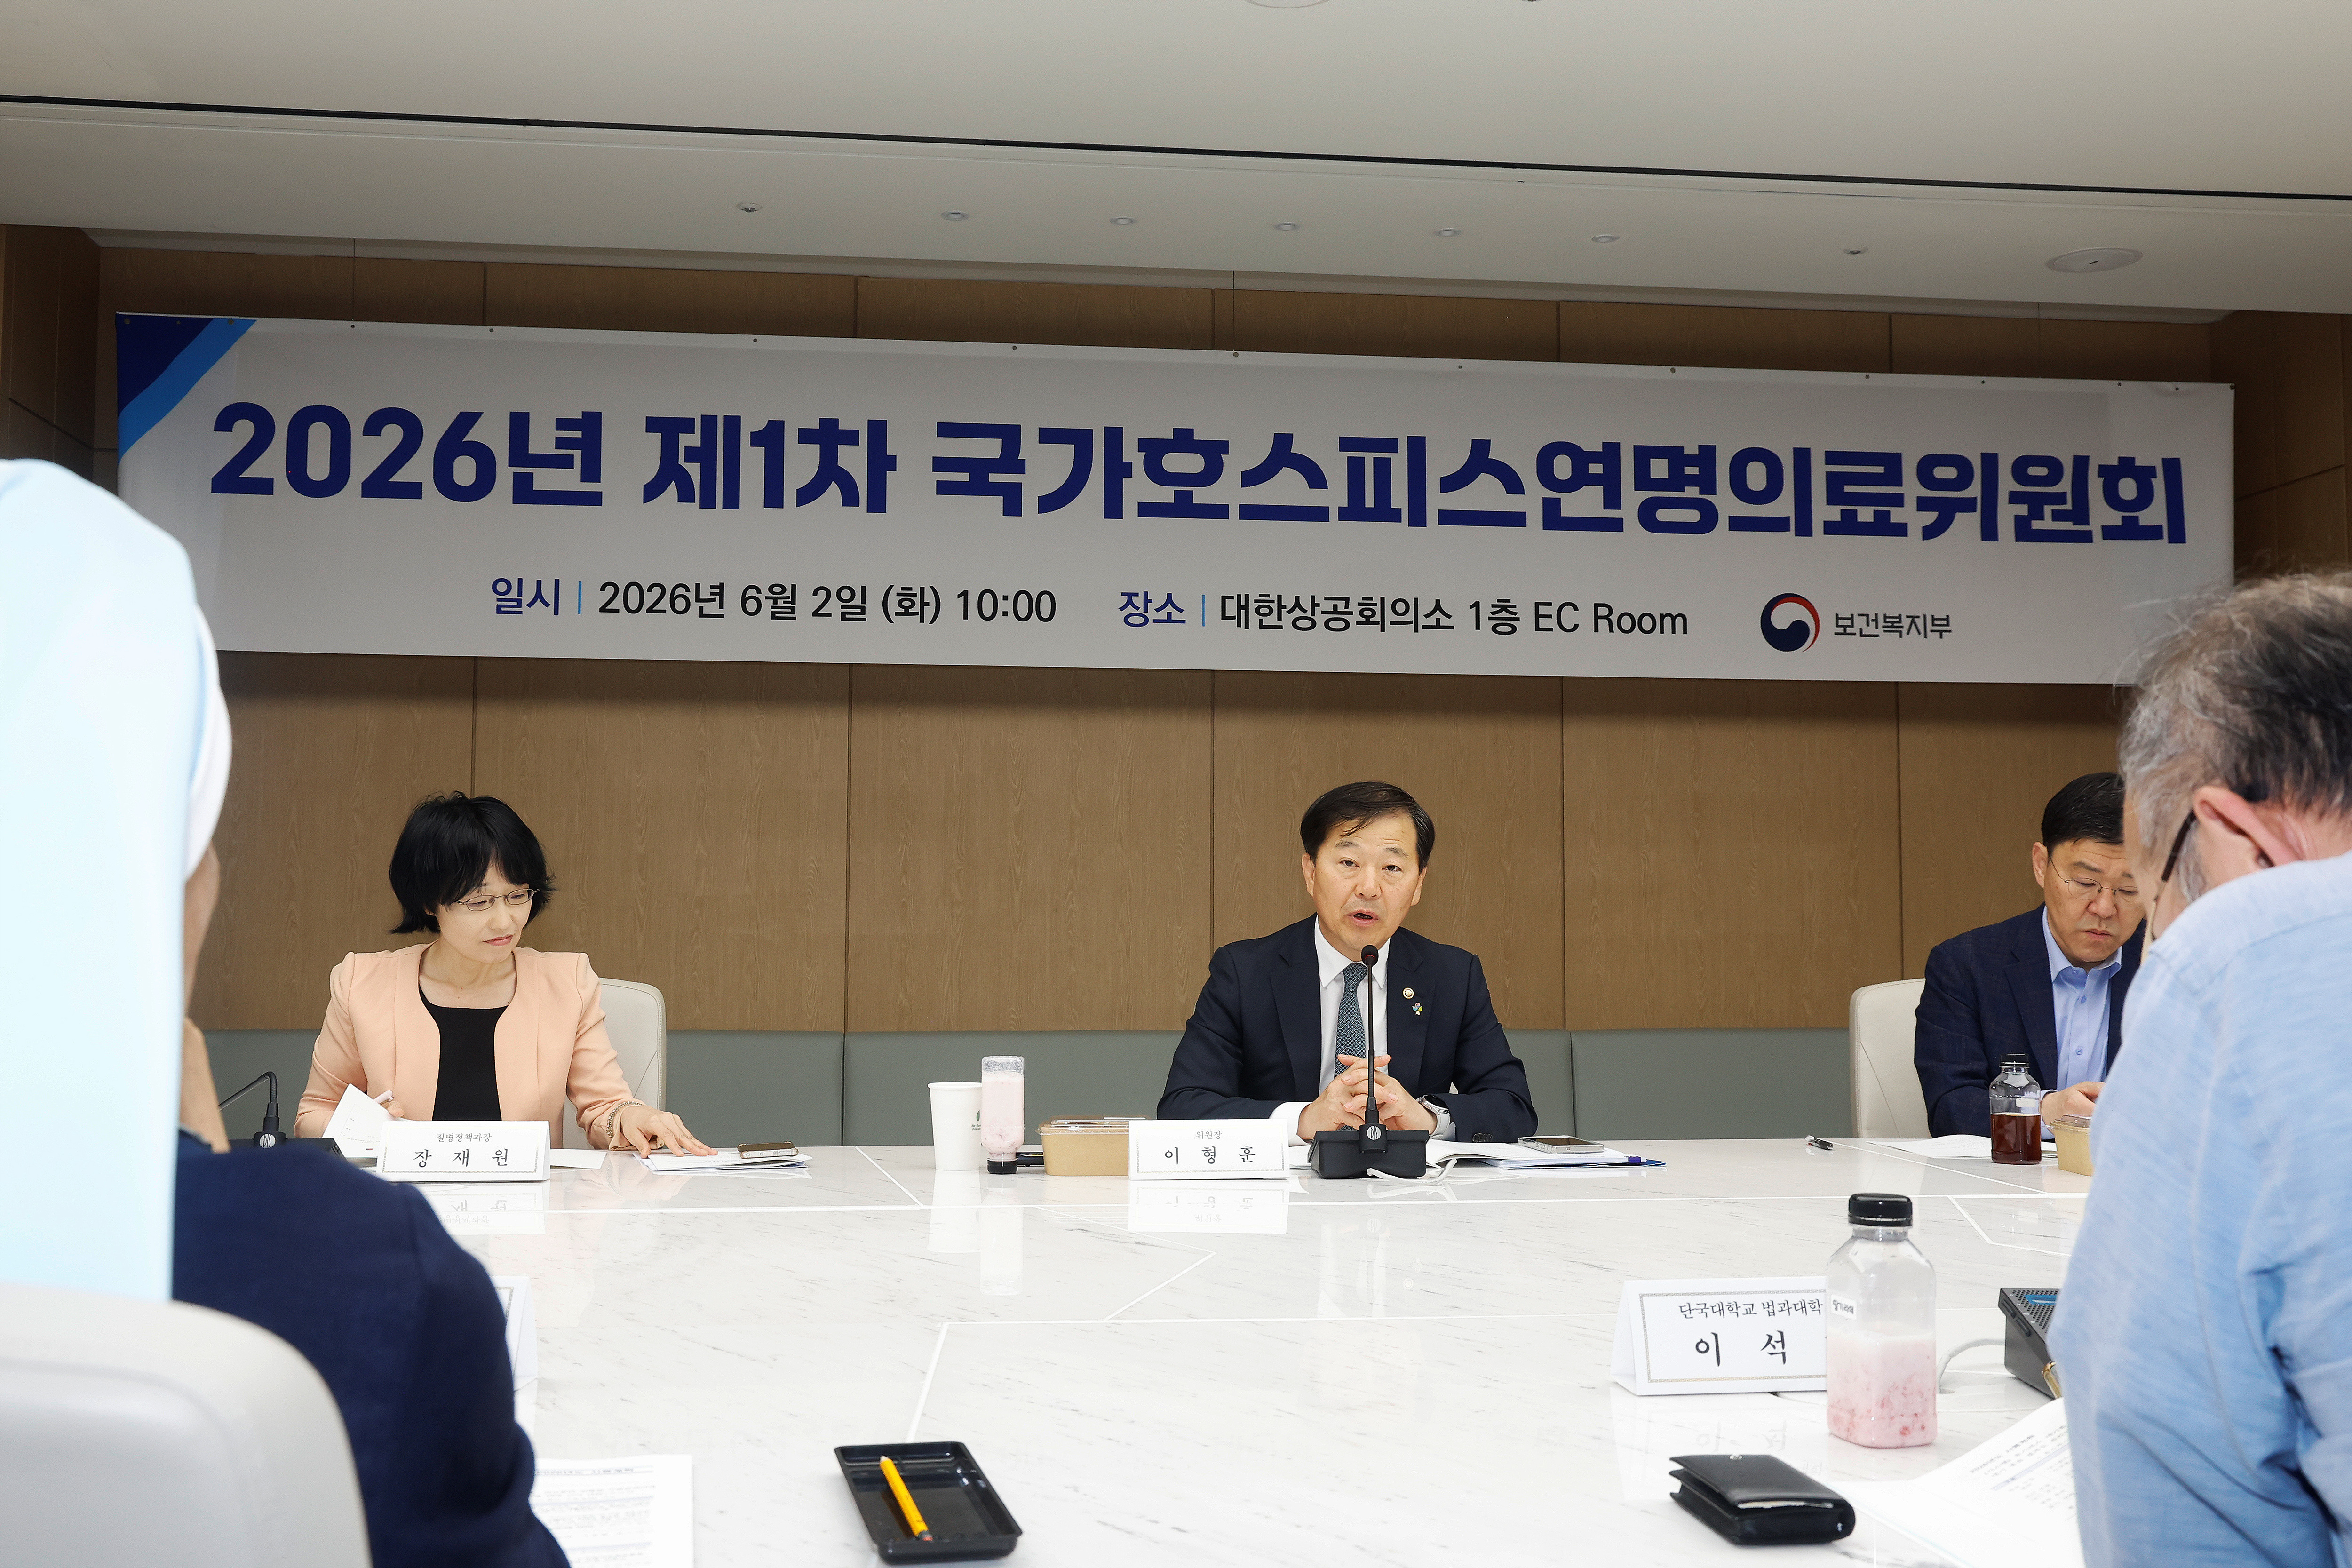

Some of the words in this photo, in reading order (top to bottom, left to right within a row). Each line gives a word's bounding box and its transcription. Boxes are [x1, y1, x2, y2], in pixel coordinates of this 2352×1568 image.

[211, 401, 603, 507] 2026년
[643, 414, 897, 514] 제1차
[932, 422, 2187, 545] 국가호스피스연명의료위원회
[492, 578, 560, 616] 일시
[599, 581, 725, 619] 2026년
[740, 583, 797, 621] 6월
[811, 585, 867, 622] 2일
[882, 584, 941, 624] (화)
[957, 589, 1057, 622] 10:00
[1118, 591, 1186, 628] 장소
[1221, 593, 1455, 633] 대한상공회의소
[1469, 598, 1521, 636] 1층
[1534, 602, 1580, 633] EC
[1593, 603, 1688, 635] Room
[1834, 613, 1953, 640] 보건복지부
[437, 1132, 492, 1142] 질병정책과장
[1195, 1130, 1223, 1140] 위원장
[1679, 1301, 1758, 1319] 단국대학교
[1762, 1298, 1823, 1317] 법과대학
